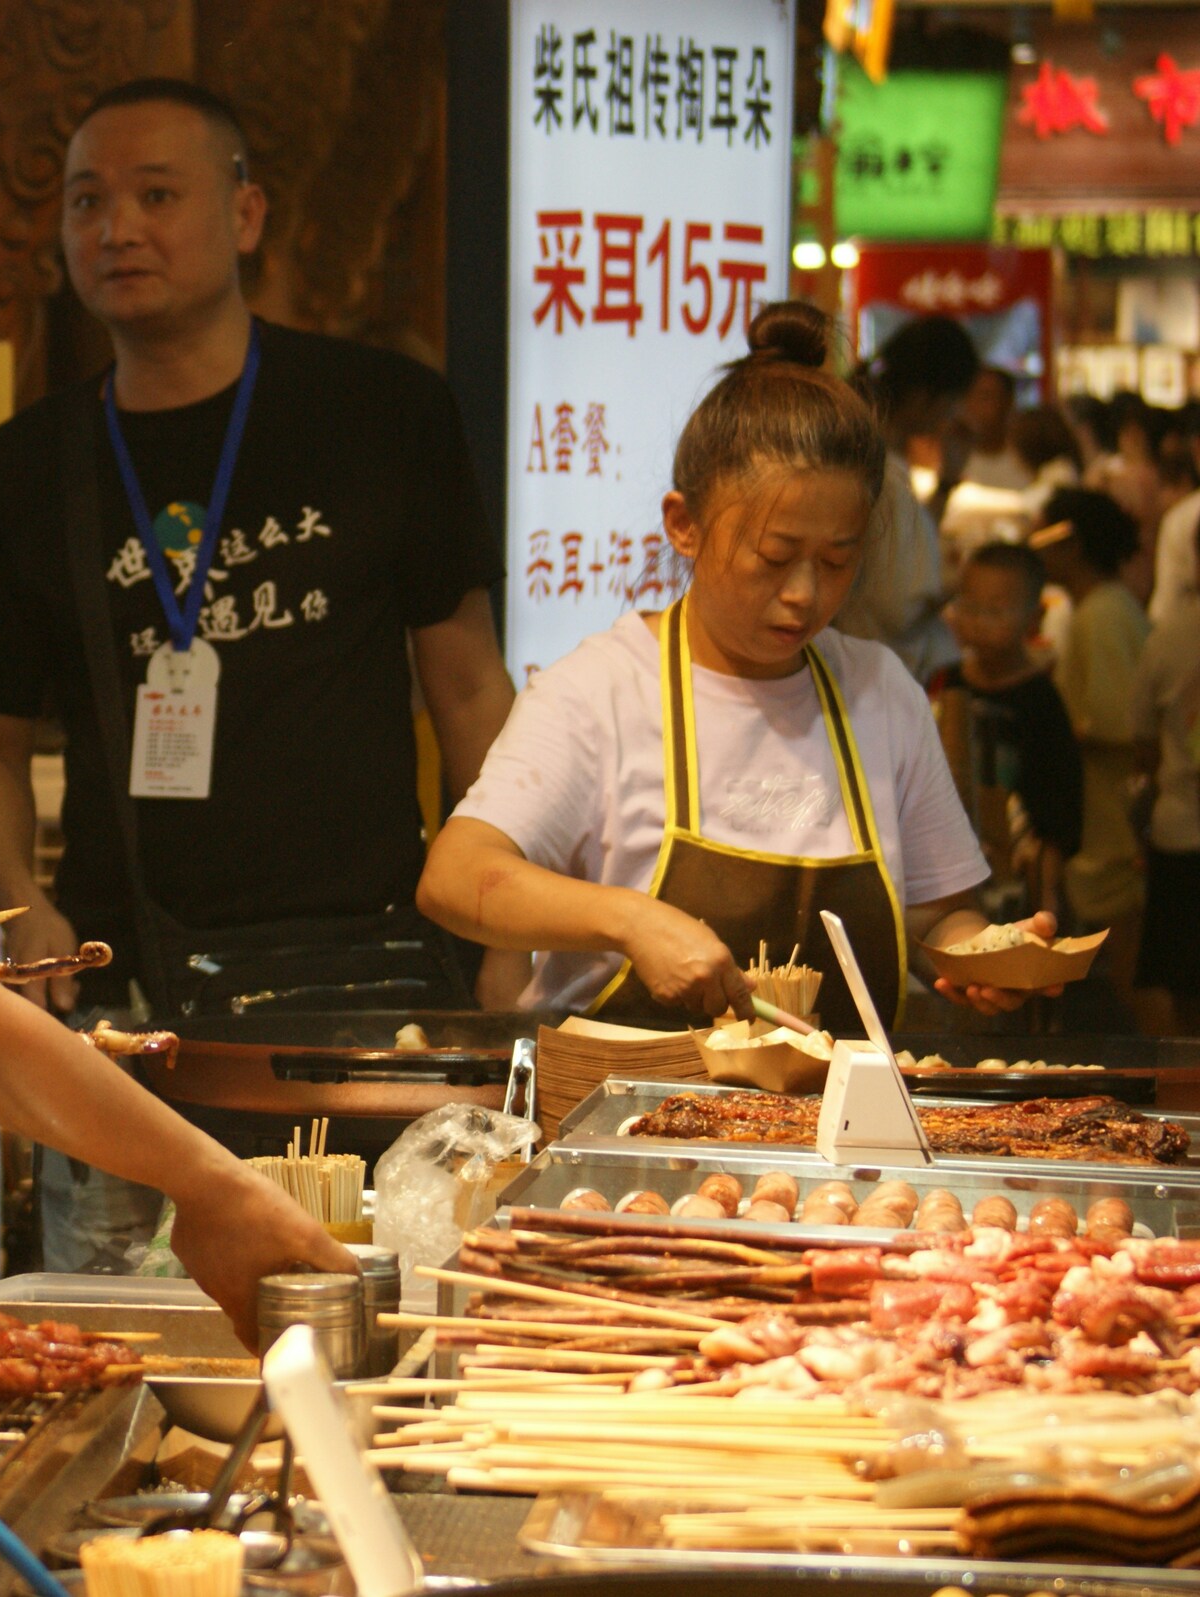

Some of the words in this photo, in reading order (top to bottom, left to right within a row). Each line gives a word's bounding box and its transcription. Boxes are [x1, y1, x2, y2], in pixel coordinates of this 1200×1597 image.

[533, 23, 772, 149] 柴氏祖传掏耳朵
[533, 210, 767, 342] 采耳15元
